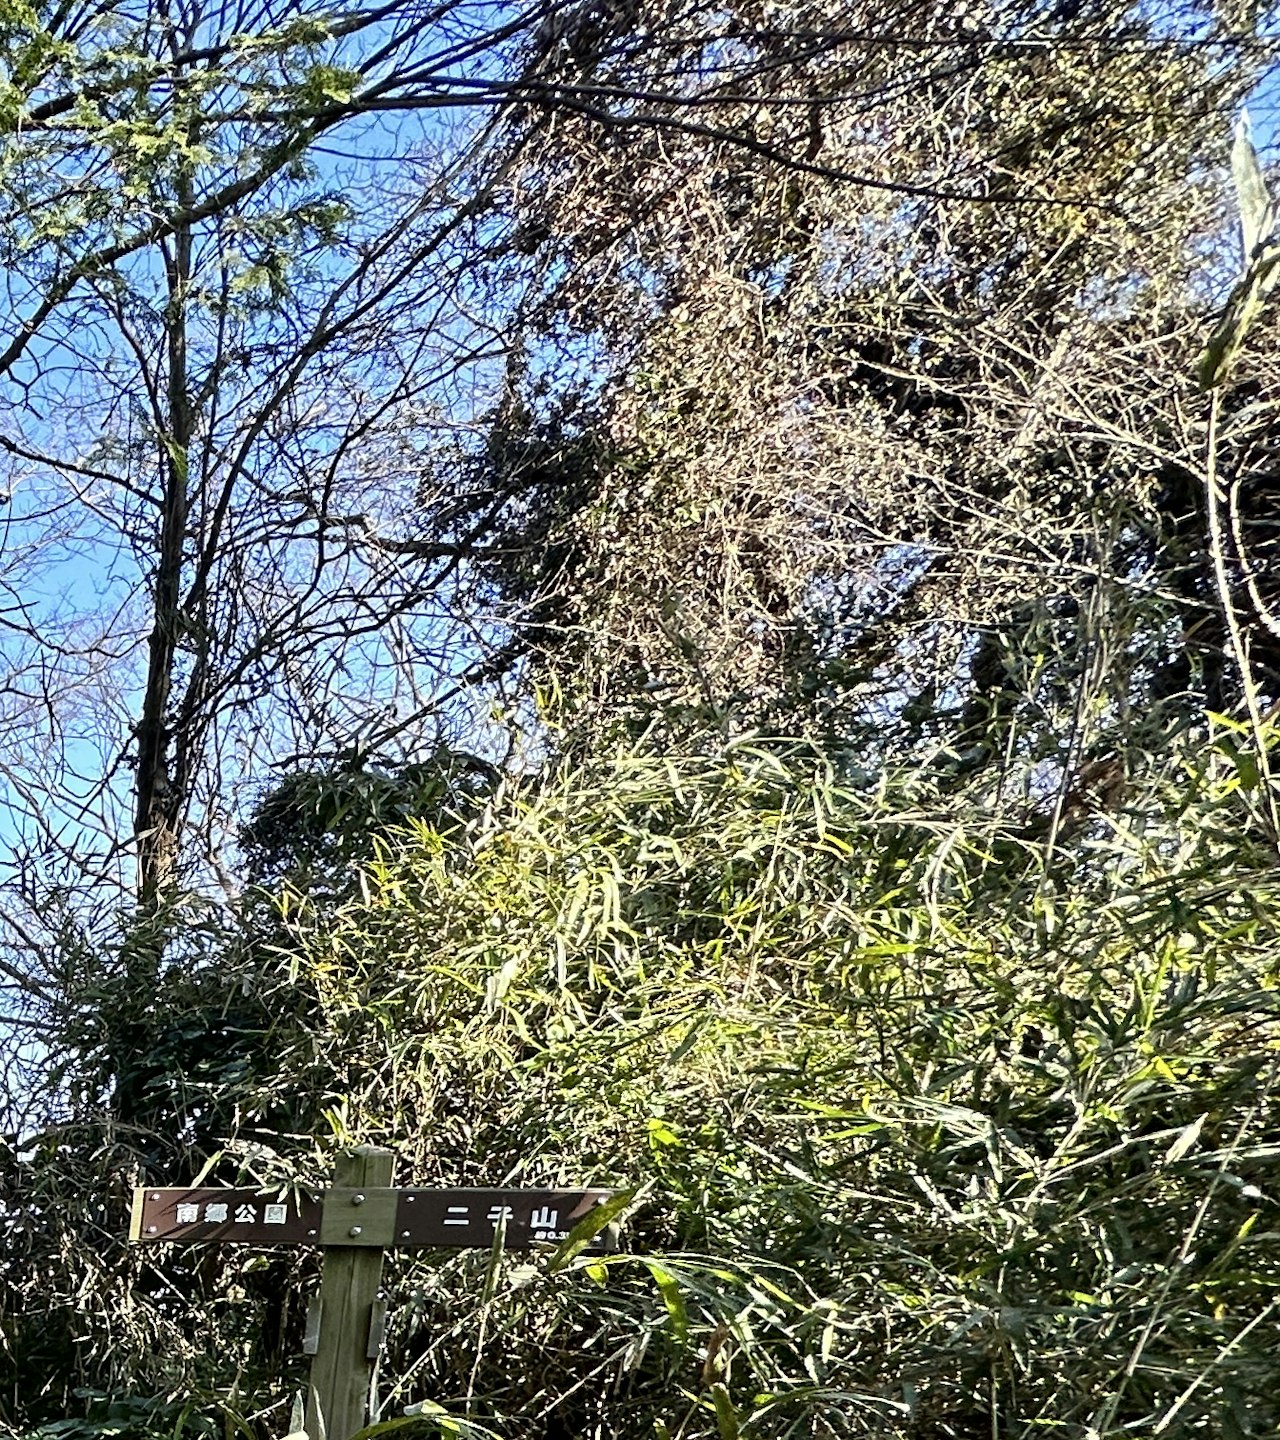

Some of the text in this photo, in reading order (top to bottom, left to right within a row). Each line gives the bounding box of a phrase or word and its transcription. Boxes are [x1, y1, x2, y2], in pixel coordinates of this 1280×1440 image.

[176, 1203, 288, 1225] 南郷公園
[443, 1206, 558, 1229] 二子山
